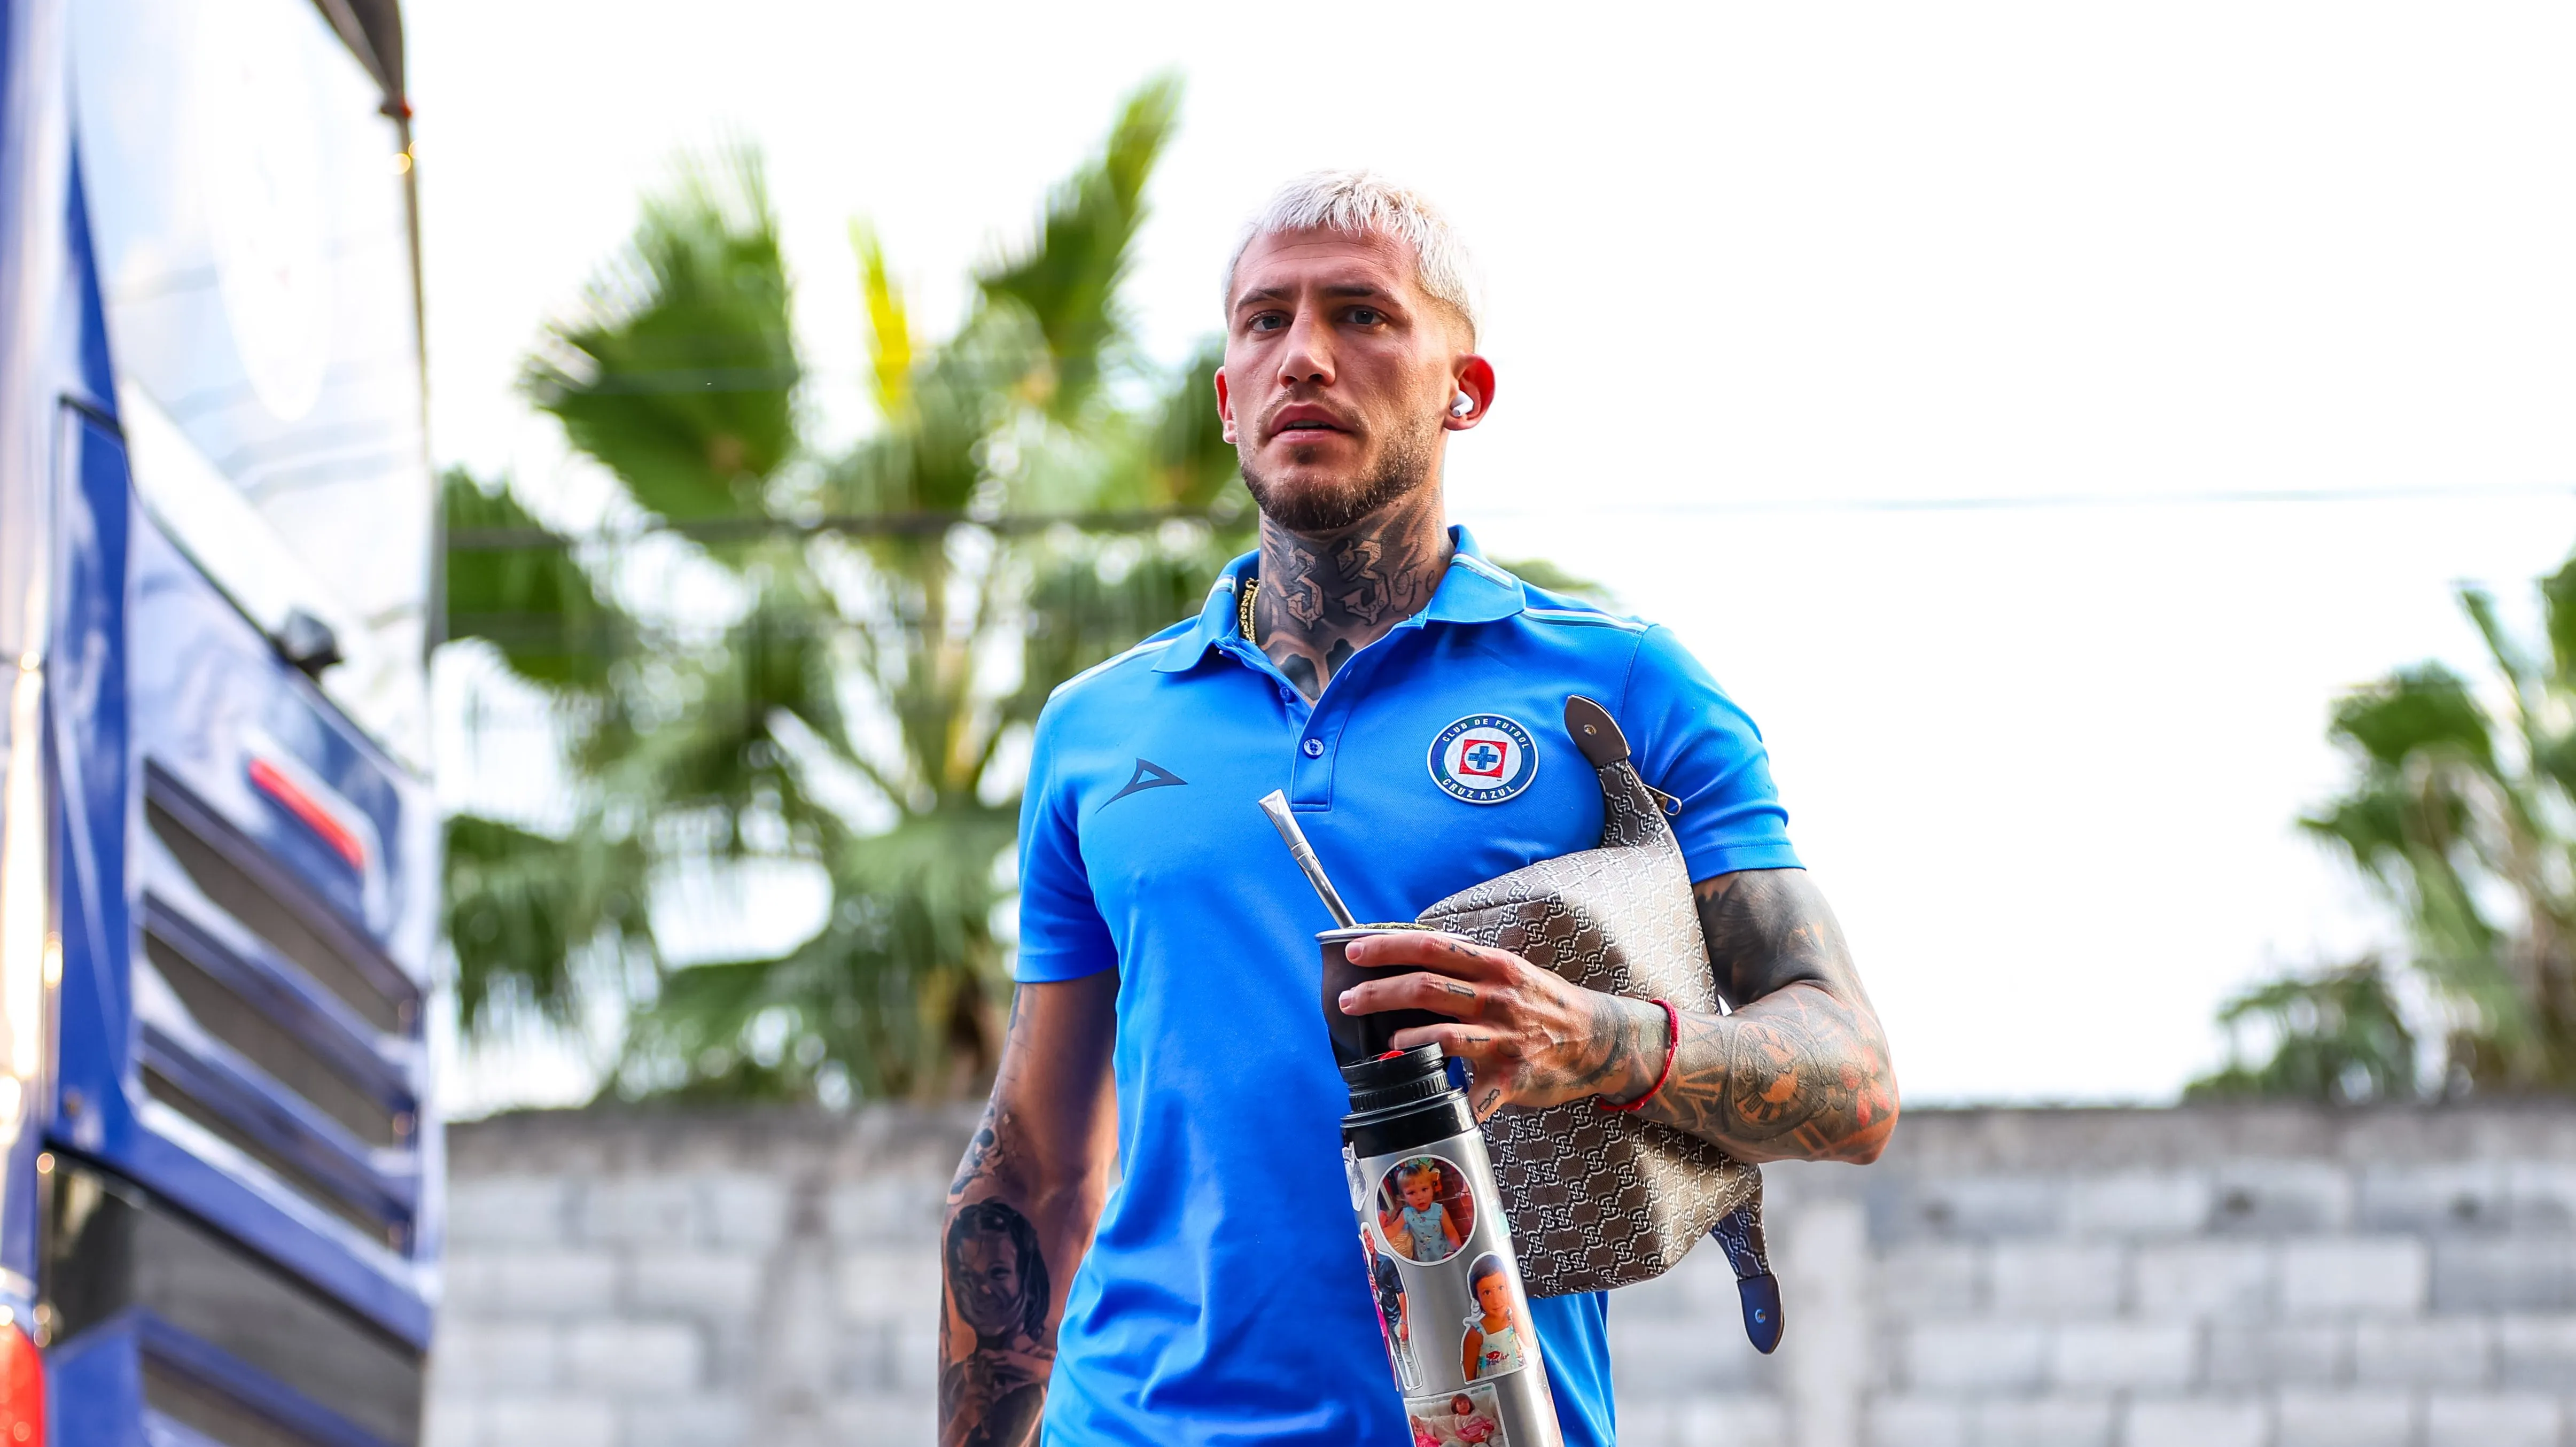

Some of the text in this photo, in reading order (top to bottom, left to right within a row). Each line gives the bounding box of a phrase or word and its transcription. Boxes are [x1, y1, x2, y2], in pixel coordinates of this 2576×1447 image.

[1442, 722, 1468, 742] CLUB
[1495, 720, 1529, 749] FUTBOL
[1442, 779, 1515, 799] CRUZ AZUL
